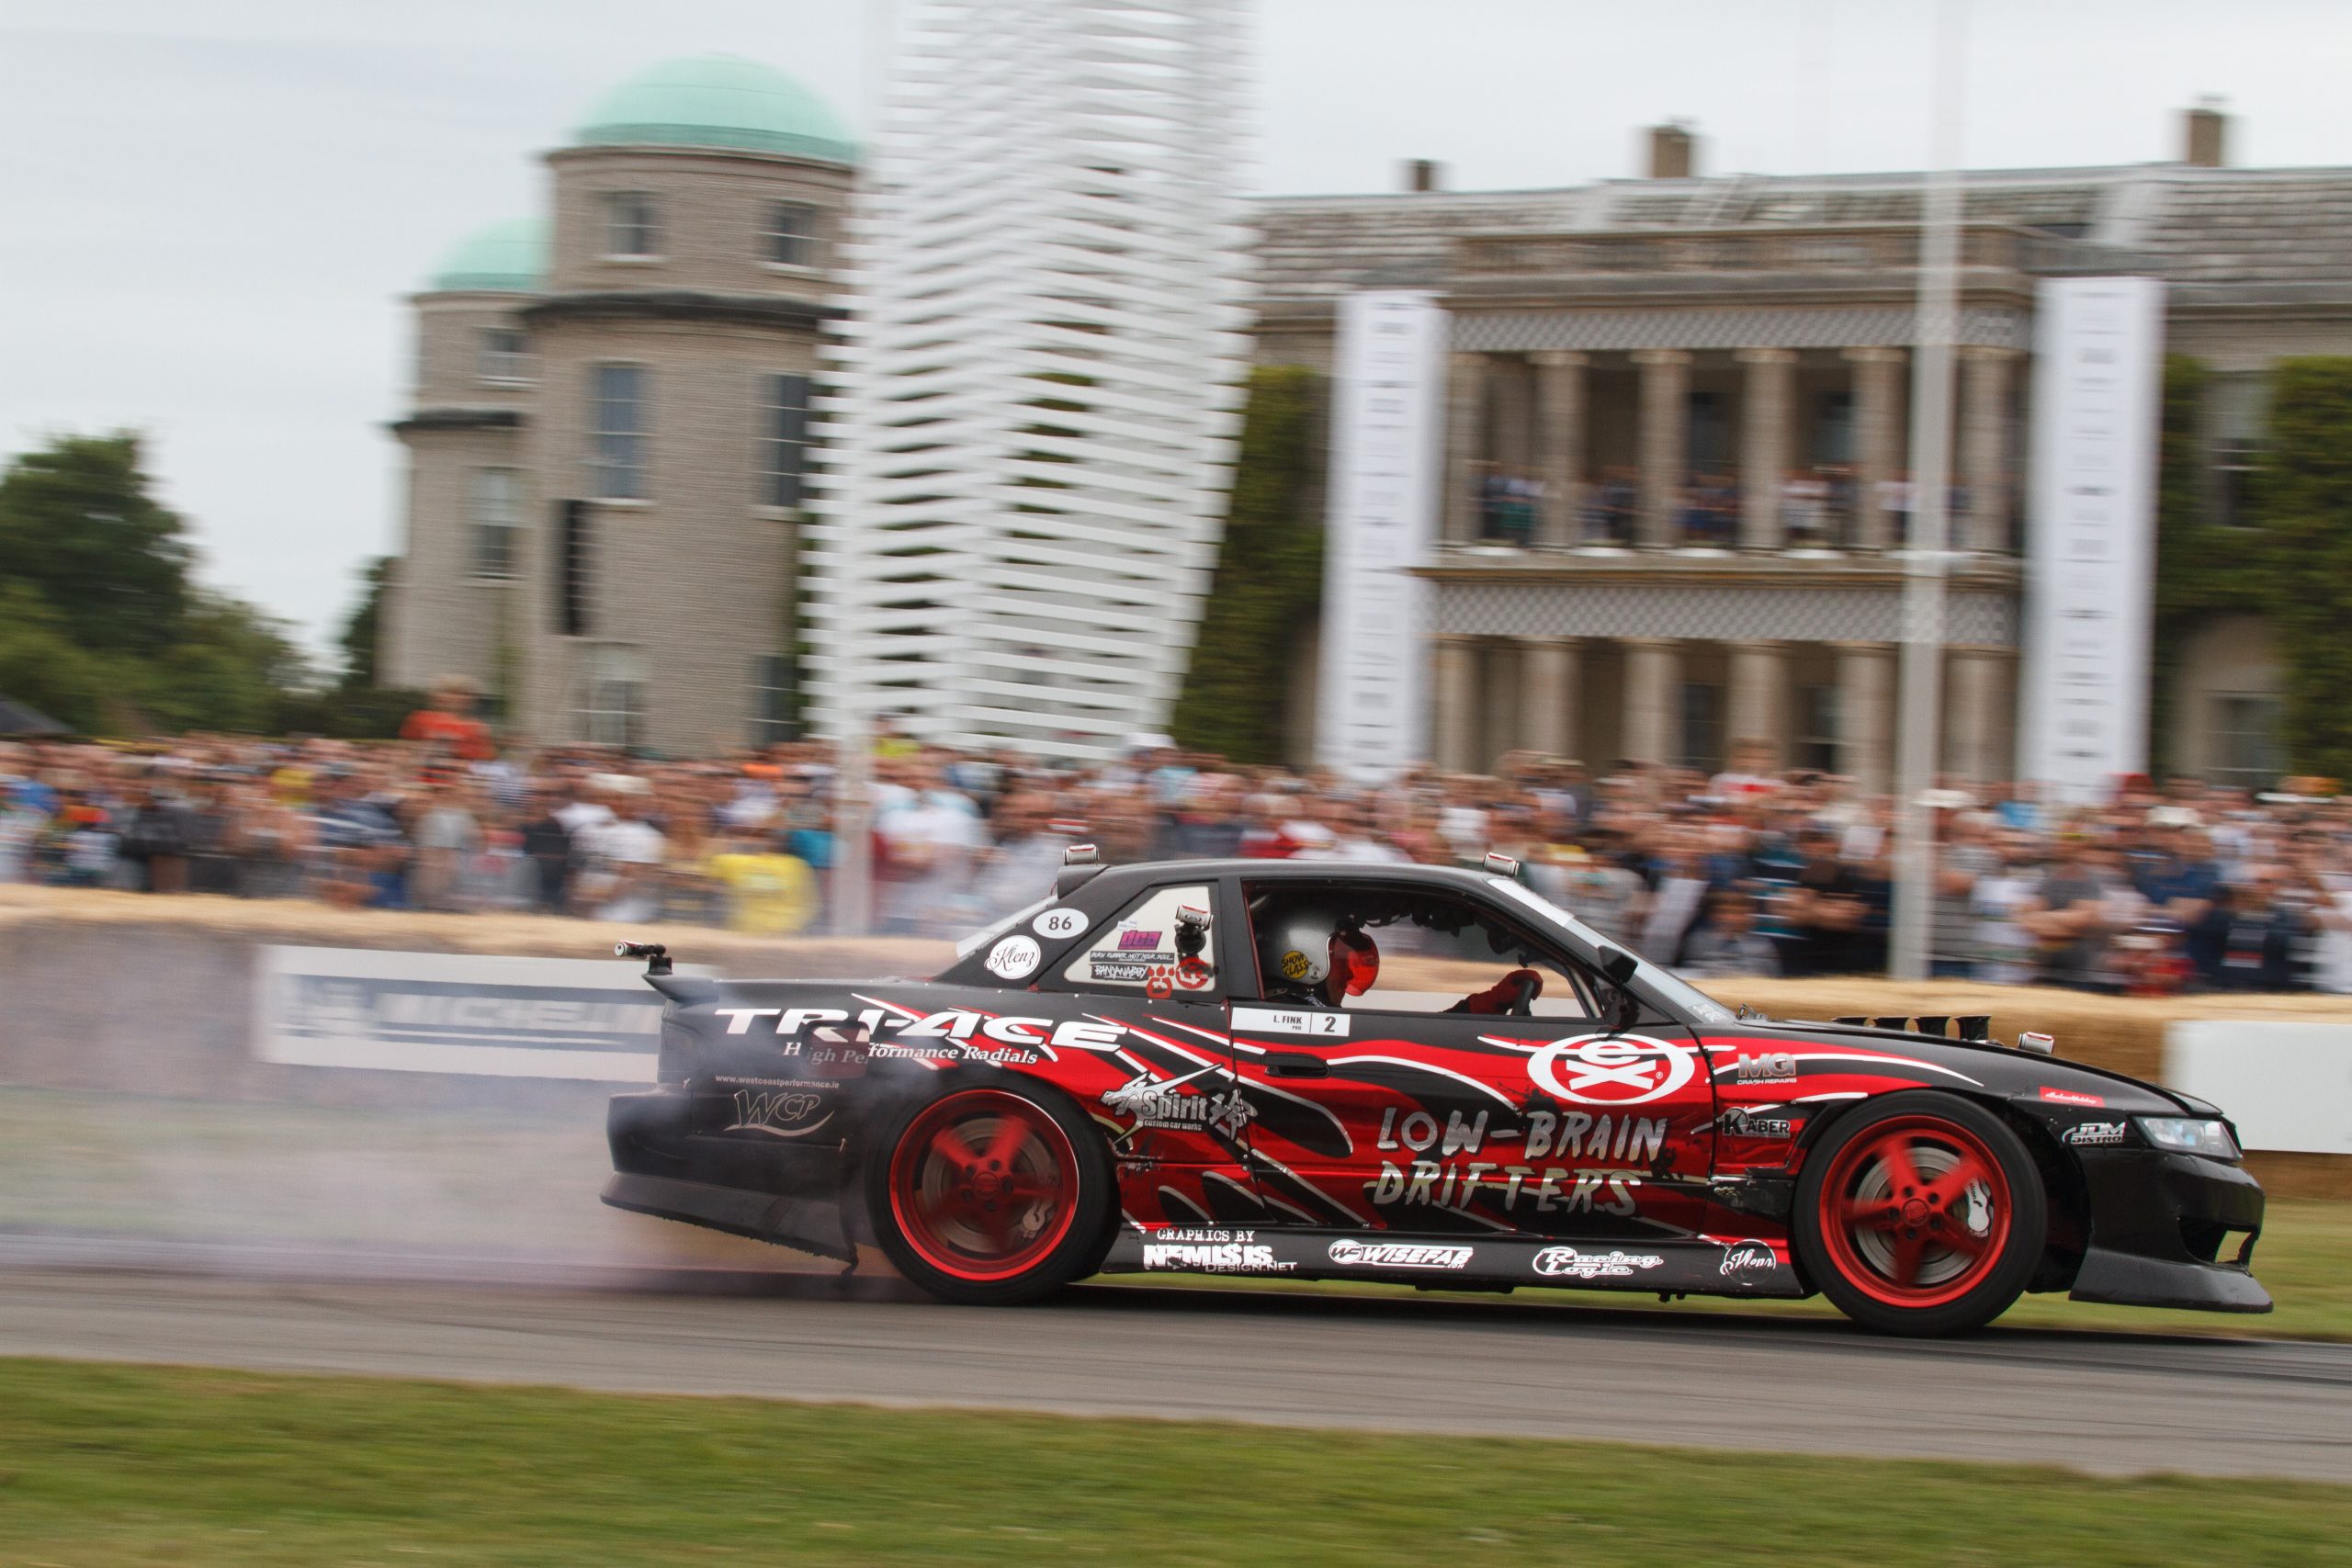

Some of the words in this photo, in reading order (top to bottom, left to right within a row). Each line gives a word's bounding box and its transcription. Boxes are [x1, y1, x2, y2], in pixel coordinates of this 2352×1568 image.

[1048, 916, 1072, 931] 86
[1282, 1016, 1302, 1024] FINK
[1324, 1016, 1336, 1032] 2
[716, 1009, 1129, 1053] TRI-ACE
[963, 1046, 1037, 1065] Radials
[1738, 1053, 1796, 1077] MG
[716, 1074, 840, 1089] www.westcoastperformance.ie
[734, 1089, 820, 1128] WCP
[1142, 1090, 1208, 1121] Spirit
[1724, 1112, 1790, 1135] KABER
[2079, 1122, 2127, 1135] JDM
[1377, 1108, 1668, 1161] LOW-BRAIN
[2071, 1135, 2123, 1145] DISTRO
[1370, 1160, 1642, 1217] DRIFTERS
[1157, 1229, 1230, 1242] GRAPHICS
[1234, 1231, 1255, 1242] BY
[1363, 1247, 1474, 1265] WISEFAB
[1545, 1249, 1664, 1269] Racing
[1545, 1261, 1633, 1278] Logic
